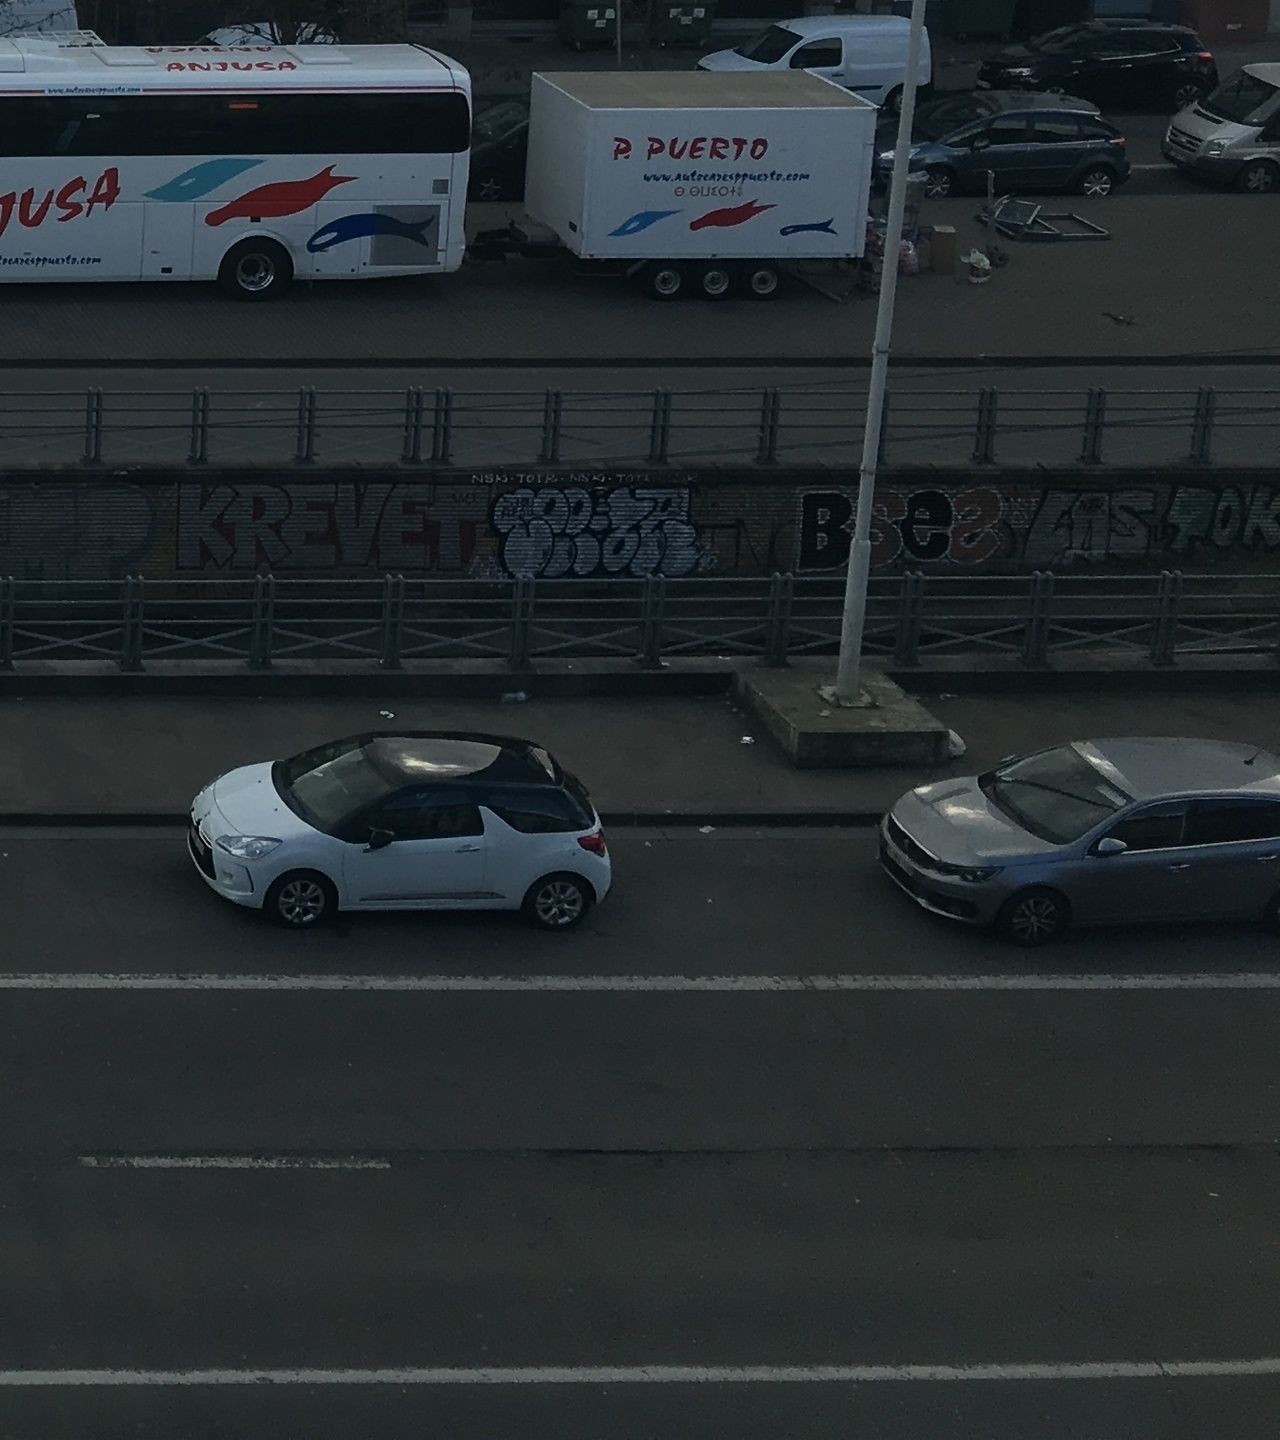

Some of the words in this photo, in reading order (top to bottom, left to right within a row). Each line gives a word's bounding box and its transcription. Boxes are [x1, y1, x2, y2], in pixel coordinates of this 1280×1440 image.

[166, 61, 297, 72] ANJUSA
[647, 137, 768, 160] PUERTO
[175, 482, 490, 570] KREVET
